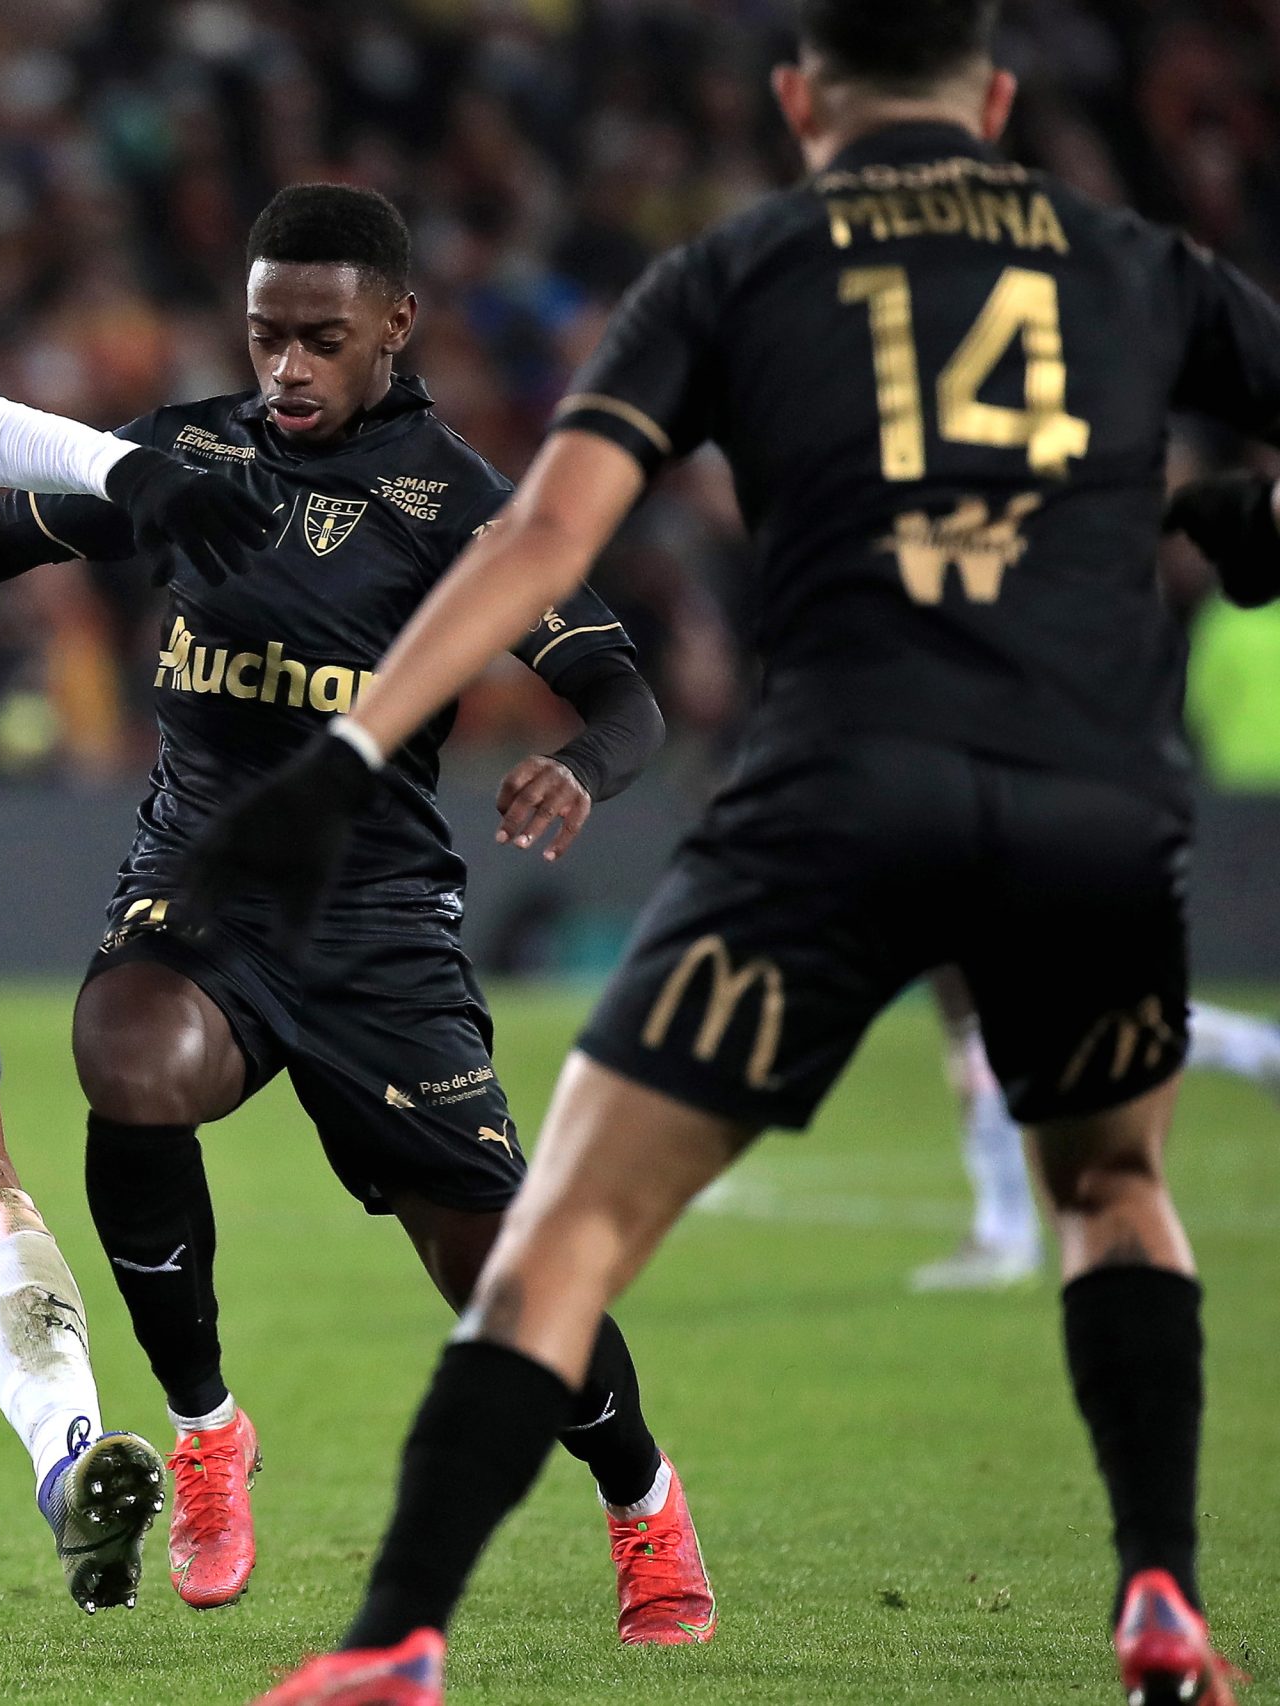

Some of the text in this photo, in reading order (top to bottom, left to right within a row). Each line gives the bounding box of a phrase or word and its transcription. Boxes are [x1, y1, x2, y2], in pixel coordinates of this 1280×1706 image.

[826, 190, 1070, 256] MEDINA
[837, 265, 1090, 483] 14
[183, 424, 219, 442] GROUPE
[393, 476, 448, 493] SMART
[381, 485, 428, 505] GOOD
[315, 499, 354, 513] RCL
[382, 493, 438, 520] THINGS
